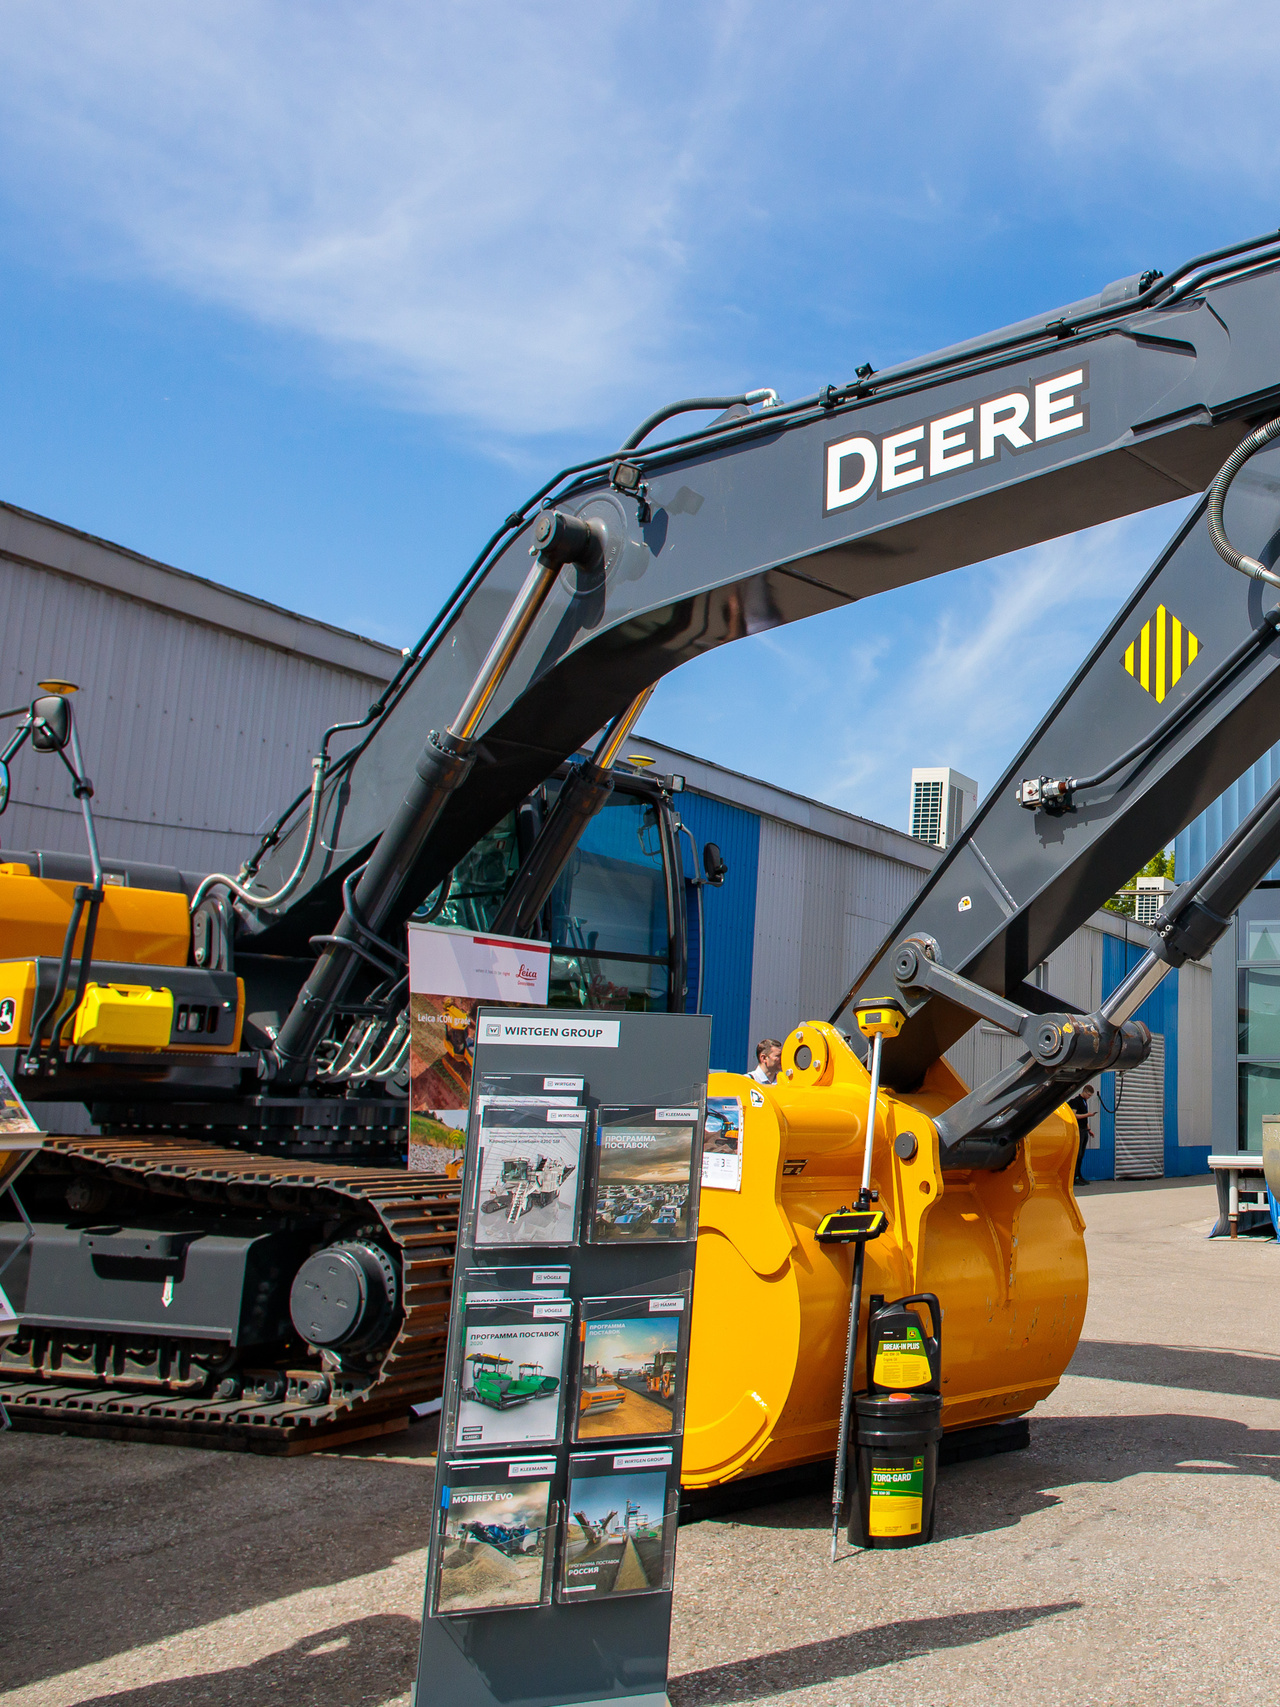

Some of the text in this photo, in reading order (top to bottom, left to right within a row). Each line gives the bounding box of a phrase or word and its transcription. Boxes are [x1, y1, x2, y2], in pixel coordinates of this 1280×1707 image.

[826, 368, 1083, 511] DEERE
[516, 964, 538, 980] Leica
[417, 1013, 436, 1023] Leica
[505, 1026, 559, 1037] WIRTGEN
[561, 1028, 603, 1038] GROUP
[470, 1332, 518, 1340] ПРОГРАММА
[883, 1342, 920, 1351] BREAK-IN PLUS
[872, 1473, 912, 1483] TORQ-GARD
[451, 1493, 494, 1504] MOBIREX
[495, 1492, 514, 1500] EVO
[568, 1566, 600, 1576] РОССИЯ
